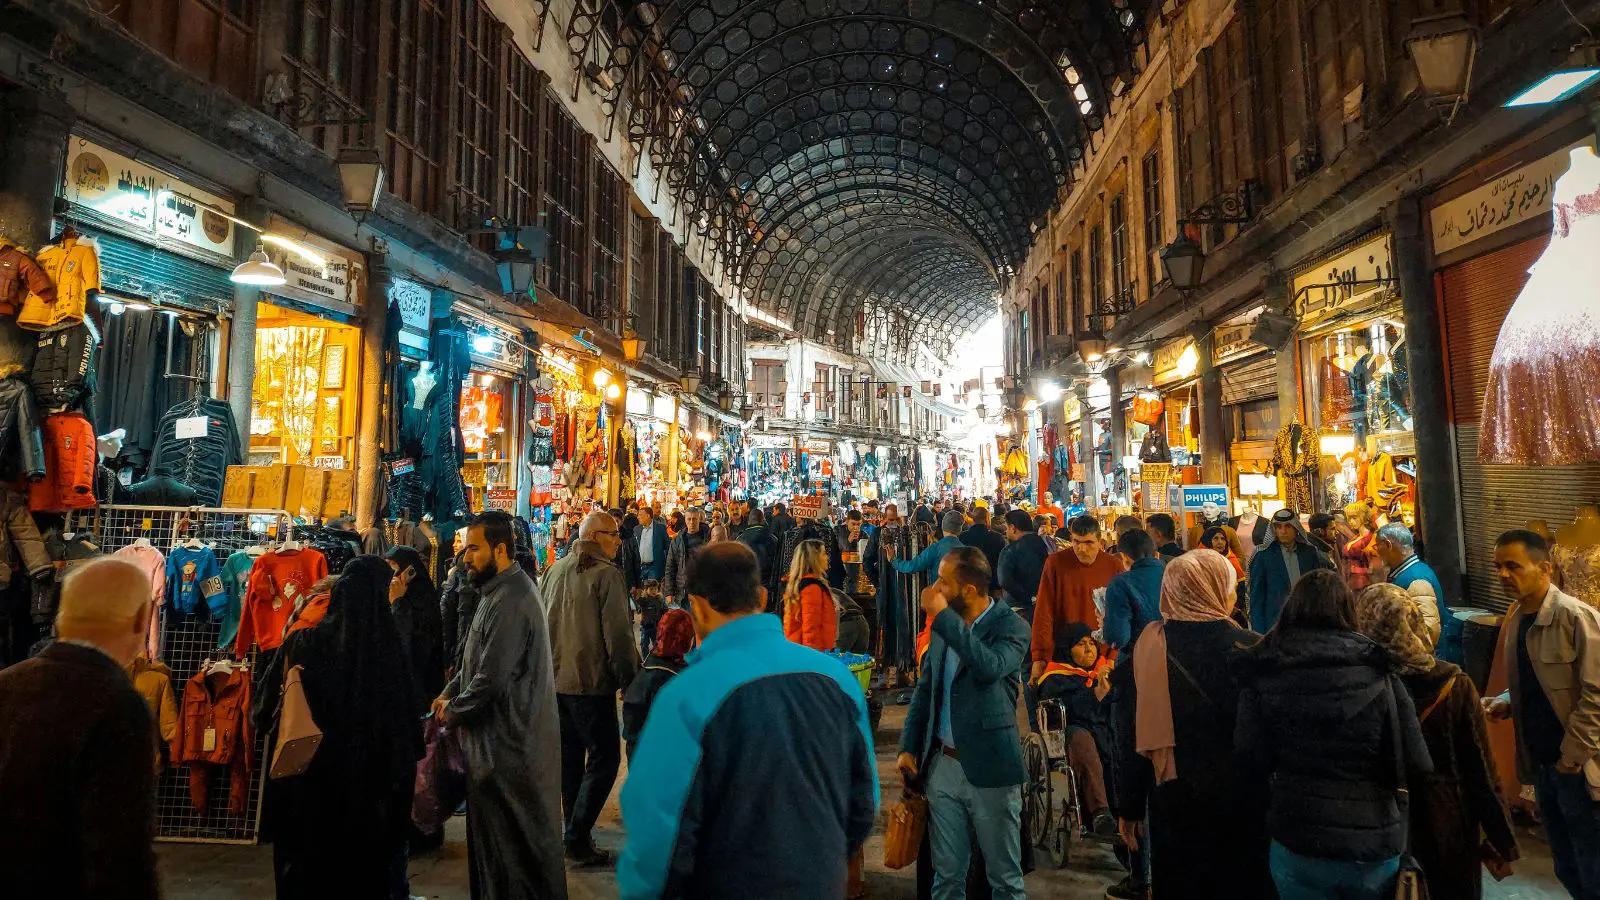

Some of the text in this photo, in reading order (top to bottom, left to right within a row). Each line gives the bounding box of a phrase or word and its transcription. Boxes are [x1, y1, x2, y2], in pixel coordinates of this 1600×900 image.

[1185, 493, 1226, 502] PHILIPS
[487, 500, 513, 509] 36000
[793, 507, 818, 517] 32000
[207, 576, 222, 592] 19
